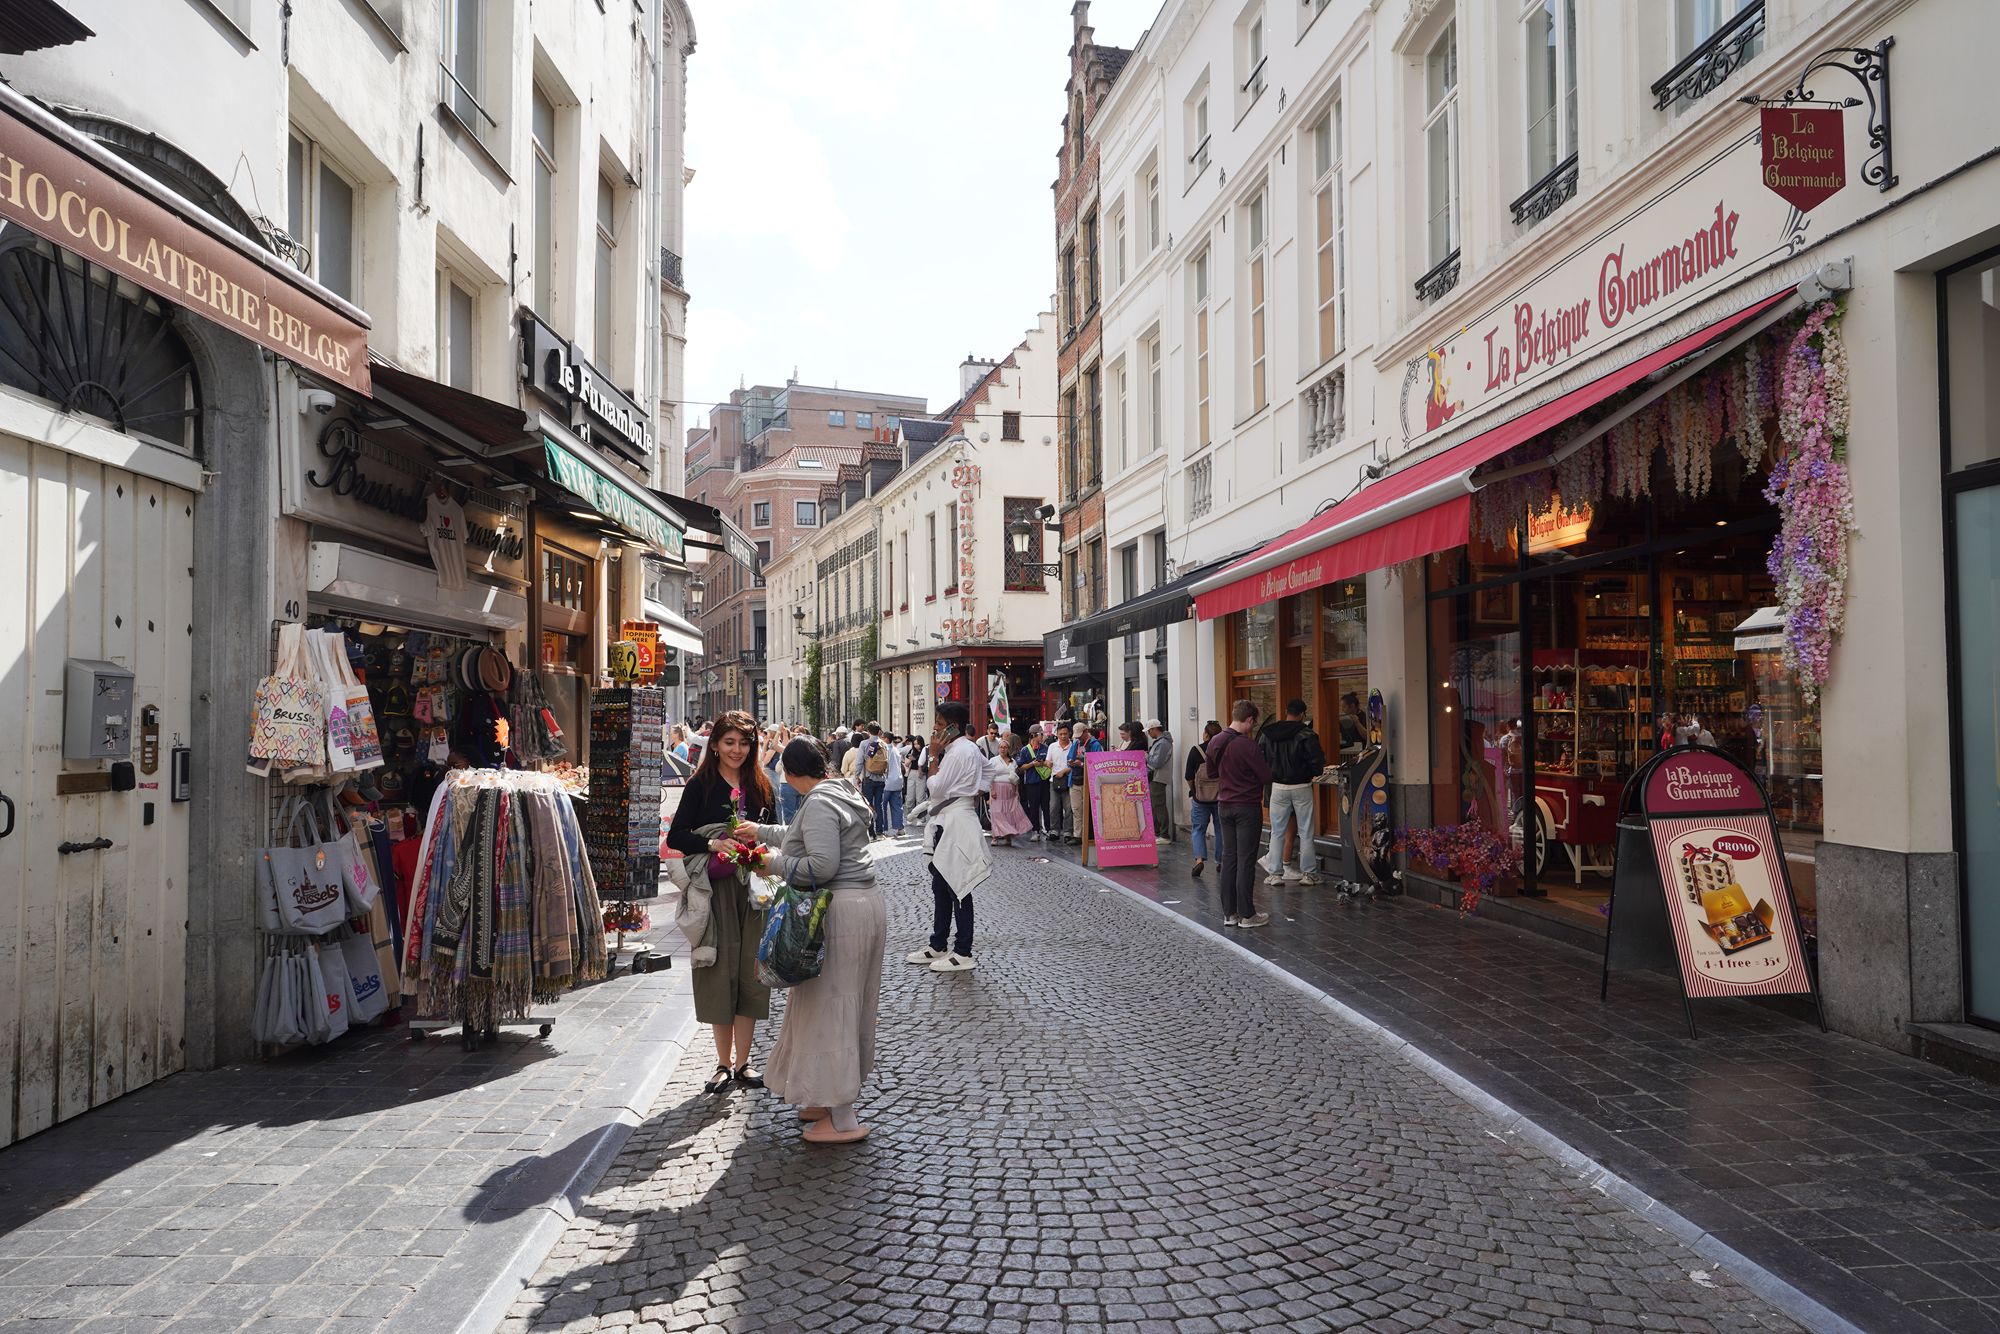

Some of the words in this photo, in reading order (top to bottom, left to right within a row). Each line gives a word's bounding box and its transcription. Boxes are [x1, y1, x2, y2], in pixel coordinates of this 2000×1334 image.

[1792, 113, 1815, 134] La
[1772, 134, 1834, 163] Belgique
[1765, 164, 1842, 188] Gourmande
[1483, 326, 1510, 395] La
[1514, 298, 1591, 386] Belgique
[1598, 200, 1740, 328] Gourmande
[268, 299, 351, 377] BELGE
[558, 349, 575, 395] le
[579, 364, 653, 456] Funambule
[557, 450, 596, 502] STAR
[602, 481, 667, 548] SOUVENIRS
[951, 464, 982, 612] Manneken
[1265, 571, 1288, 600] Belgique
[1288, 560, 1323, 590] Gourmande
[285, 600, 299, 619] 40
[1094, 760, 1123, 770] BRUSSELS
[1126, 780, 1145, 795] €1
[1675, 766, 1733, 788] Belgique
[1666, 780, 1740, 801] Gourmande
[1717, 841, 1755, 854] PROMO
[292, 883, 340, 906] Brussels
[1703, 960, 1710, 969] 4
[1727, 958, 1751, 969] free
